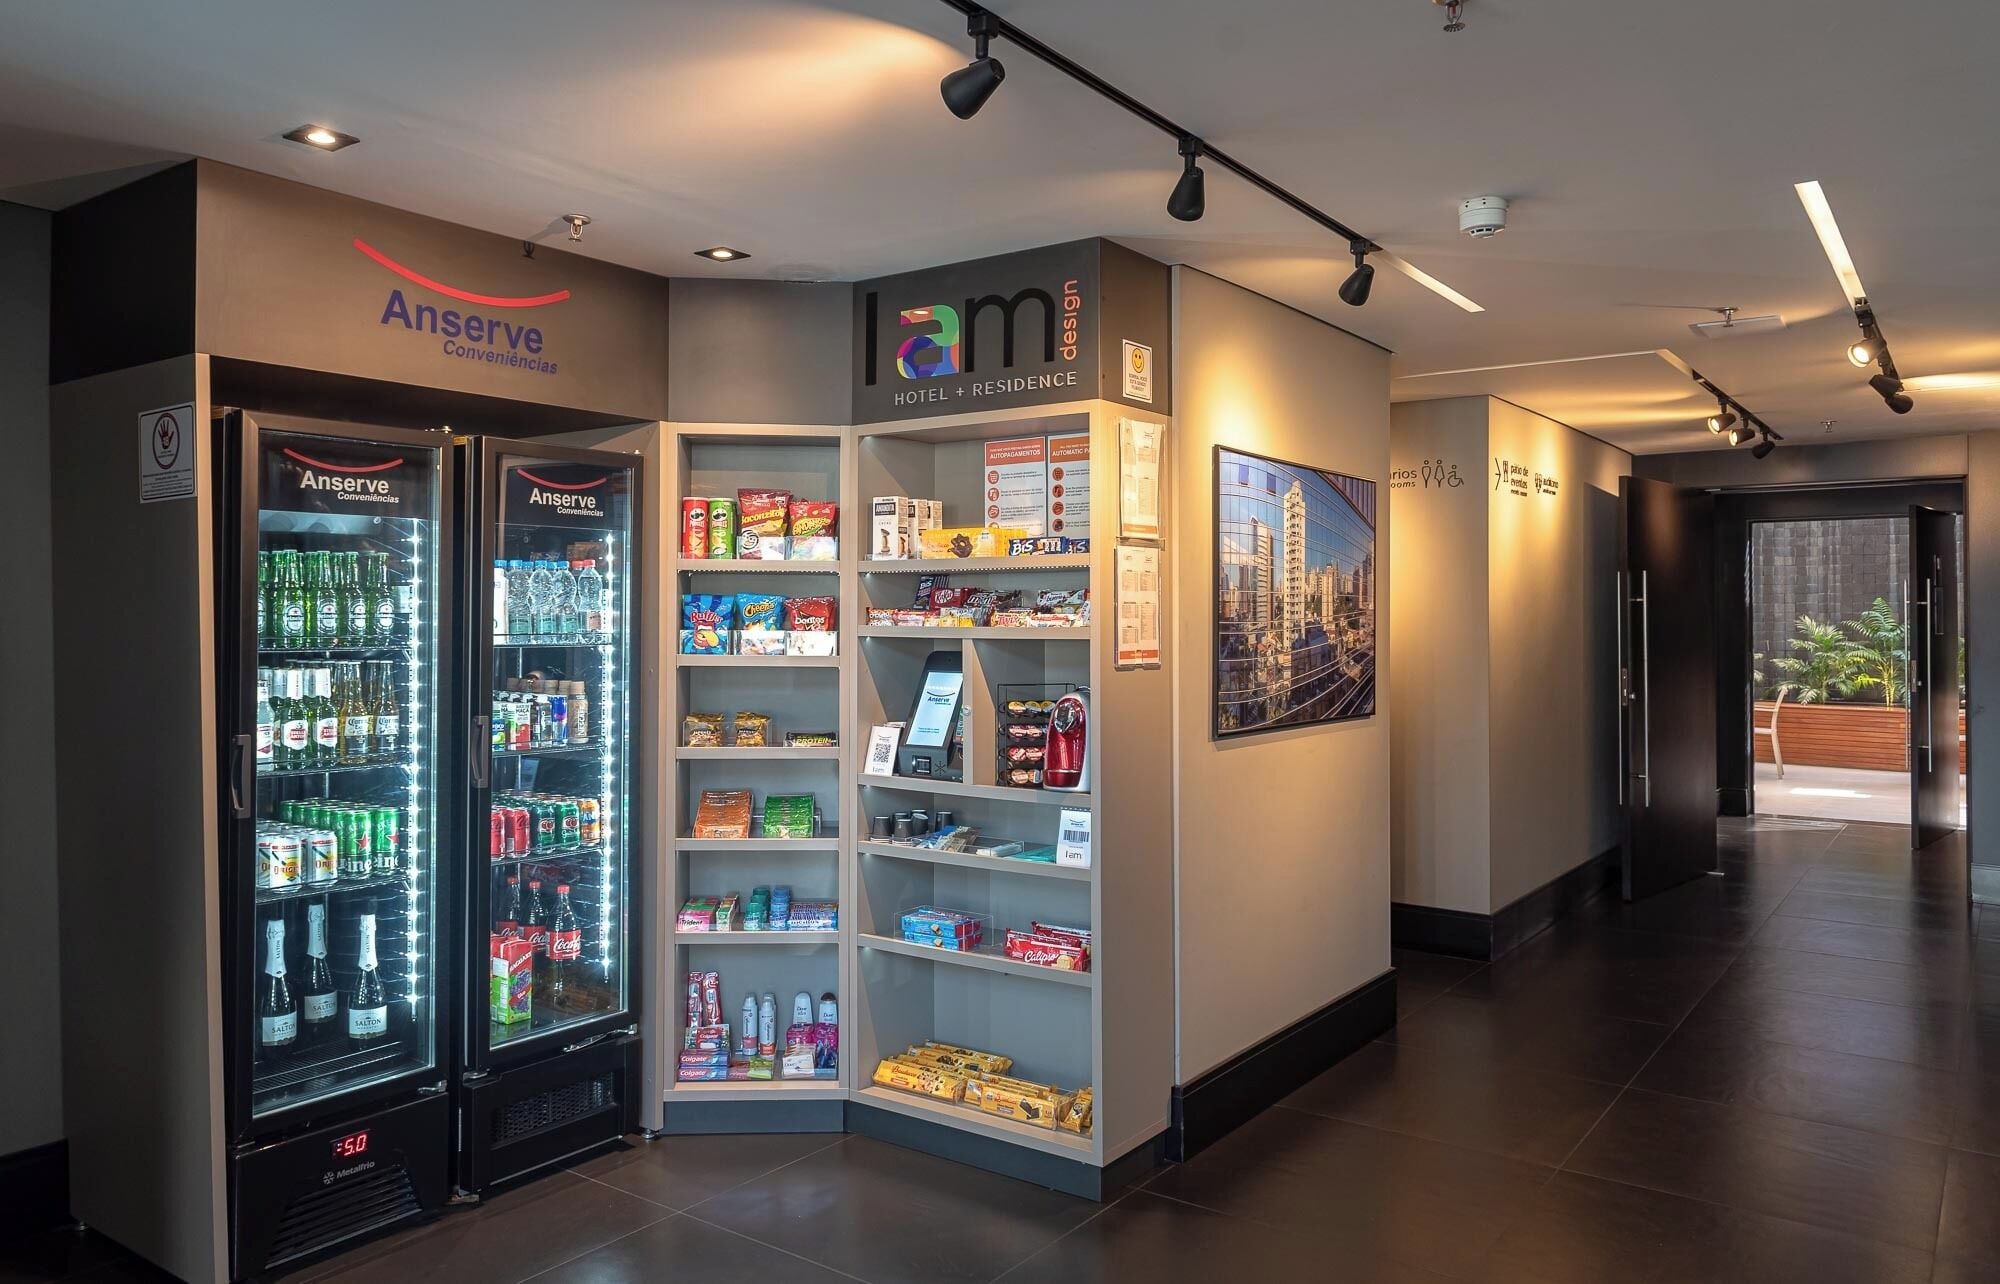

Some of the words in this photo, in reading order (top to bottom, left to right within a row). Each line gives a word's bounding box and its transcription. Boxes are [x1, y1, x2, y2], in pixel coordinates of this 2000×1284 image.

[381, 289, 543, 353] Anserve
[1060, 279, 1080, 361] design
[865, 292, 878, 385] I
[443, 339, 558, 374] Conveniências
[894, 387, 949, 405] HOTEL
[972, 371, 1078, 396] RESIDENCE
[989, 449, 1041, 460] AUTOPAGAMENTOS
[1052, 448, 1084, 457] AUTOMATIC
[300, 470, 389, 494] Anserve
[337, 492, 400, 503] Conveniências
[529, 488, 596, 509] Anserve
[557, 506, 604, 517] Conveniências
[1024, 950, 1059, 966] Calipso
[271, 1023, 296, 1034] SALTON
[354, 1018, 382, 1027] SALTON
[681, 1055, 708, 1063] Colgate
[680, 1069, 707, 1077] Colgate
[336, 1160, 376, 1179] Metalfrio
